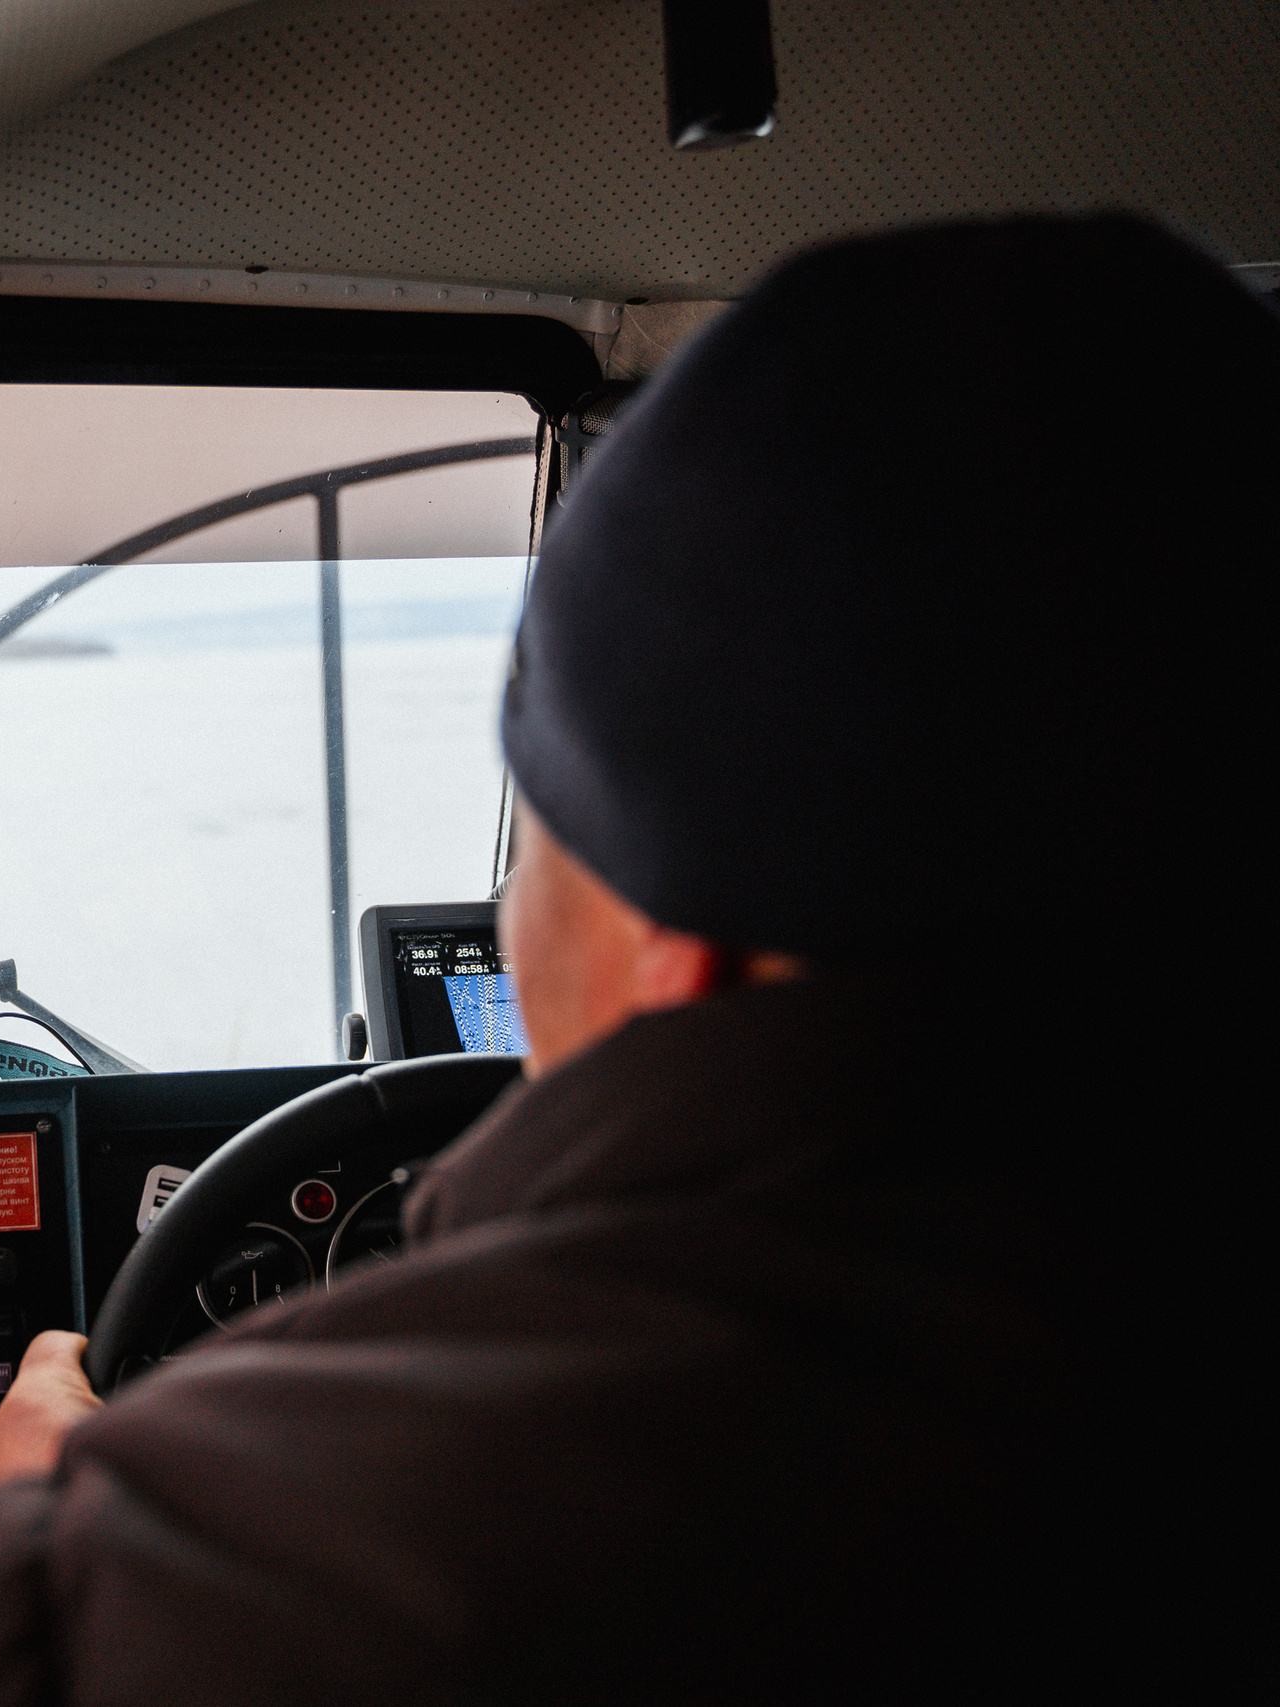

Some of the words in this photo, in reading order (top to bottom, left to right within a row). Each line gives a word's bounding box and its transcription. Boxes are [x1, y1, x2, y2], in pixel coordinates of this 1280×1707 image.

[455, 947, 476, 958] 254
[454, 964, 483, 974] 08:58
[9, 1198, 30, 1206] винт
